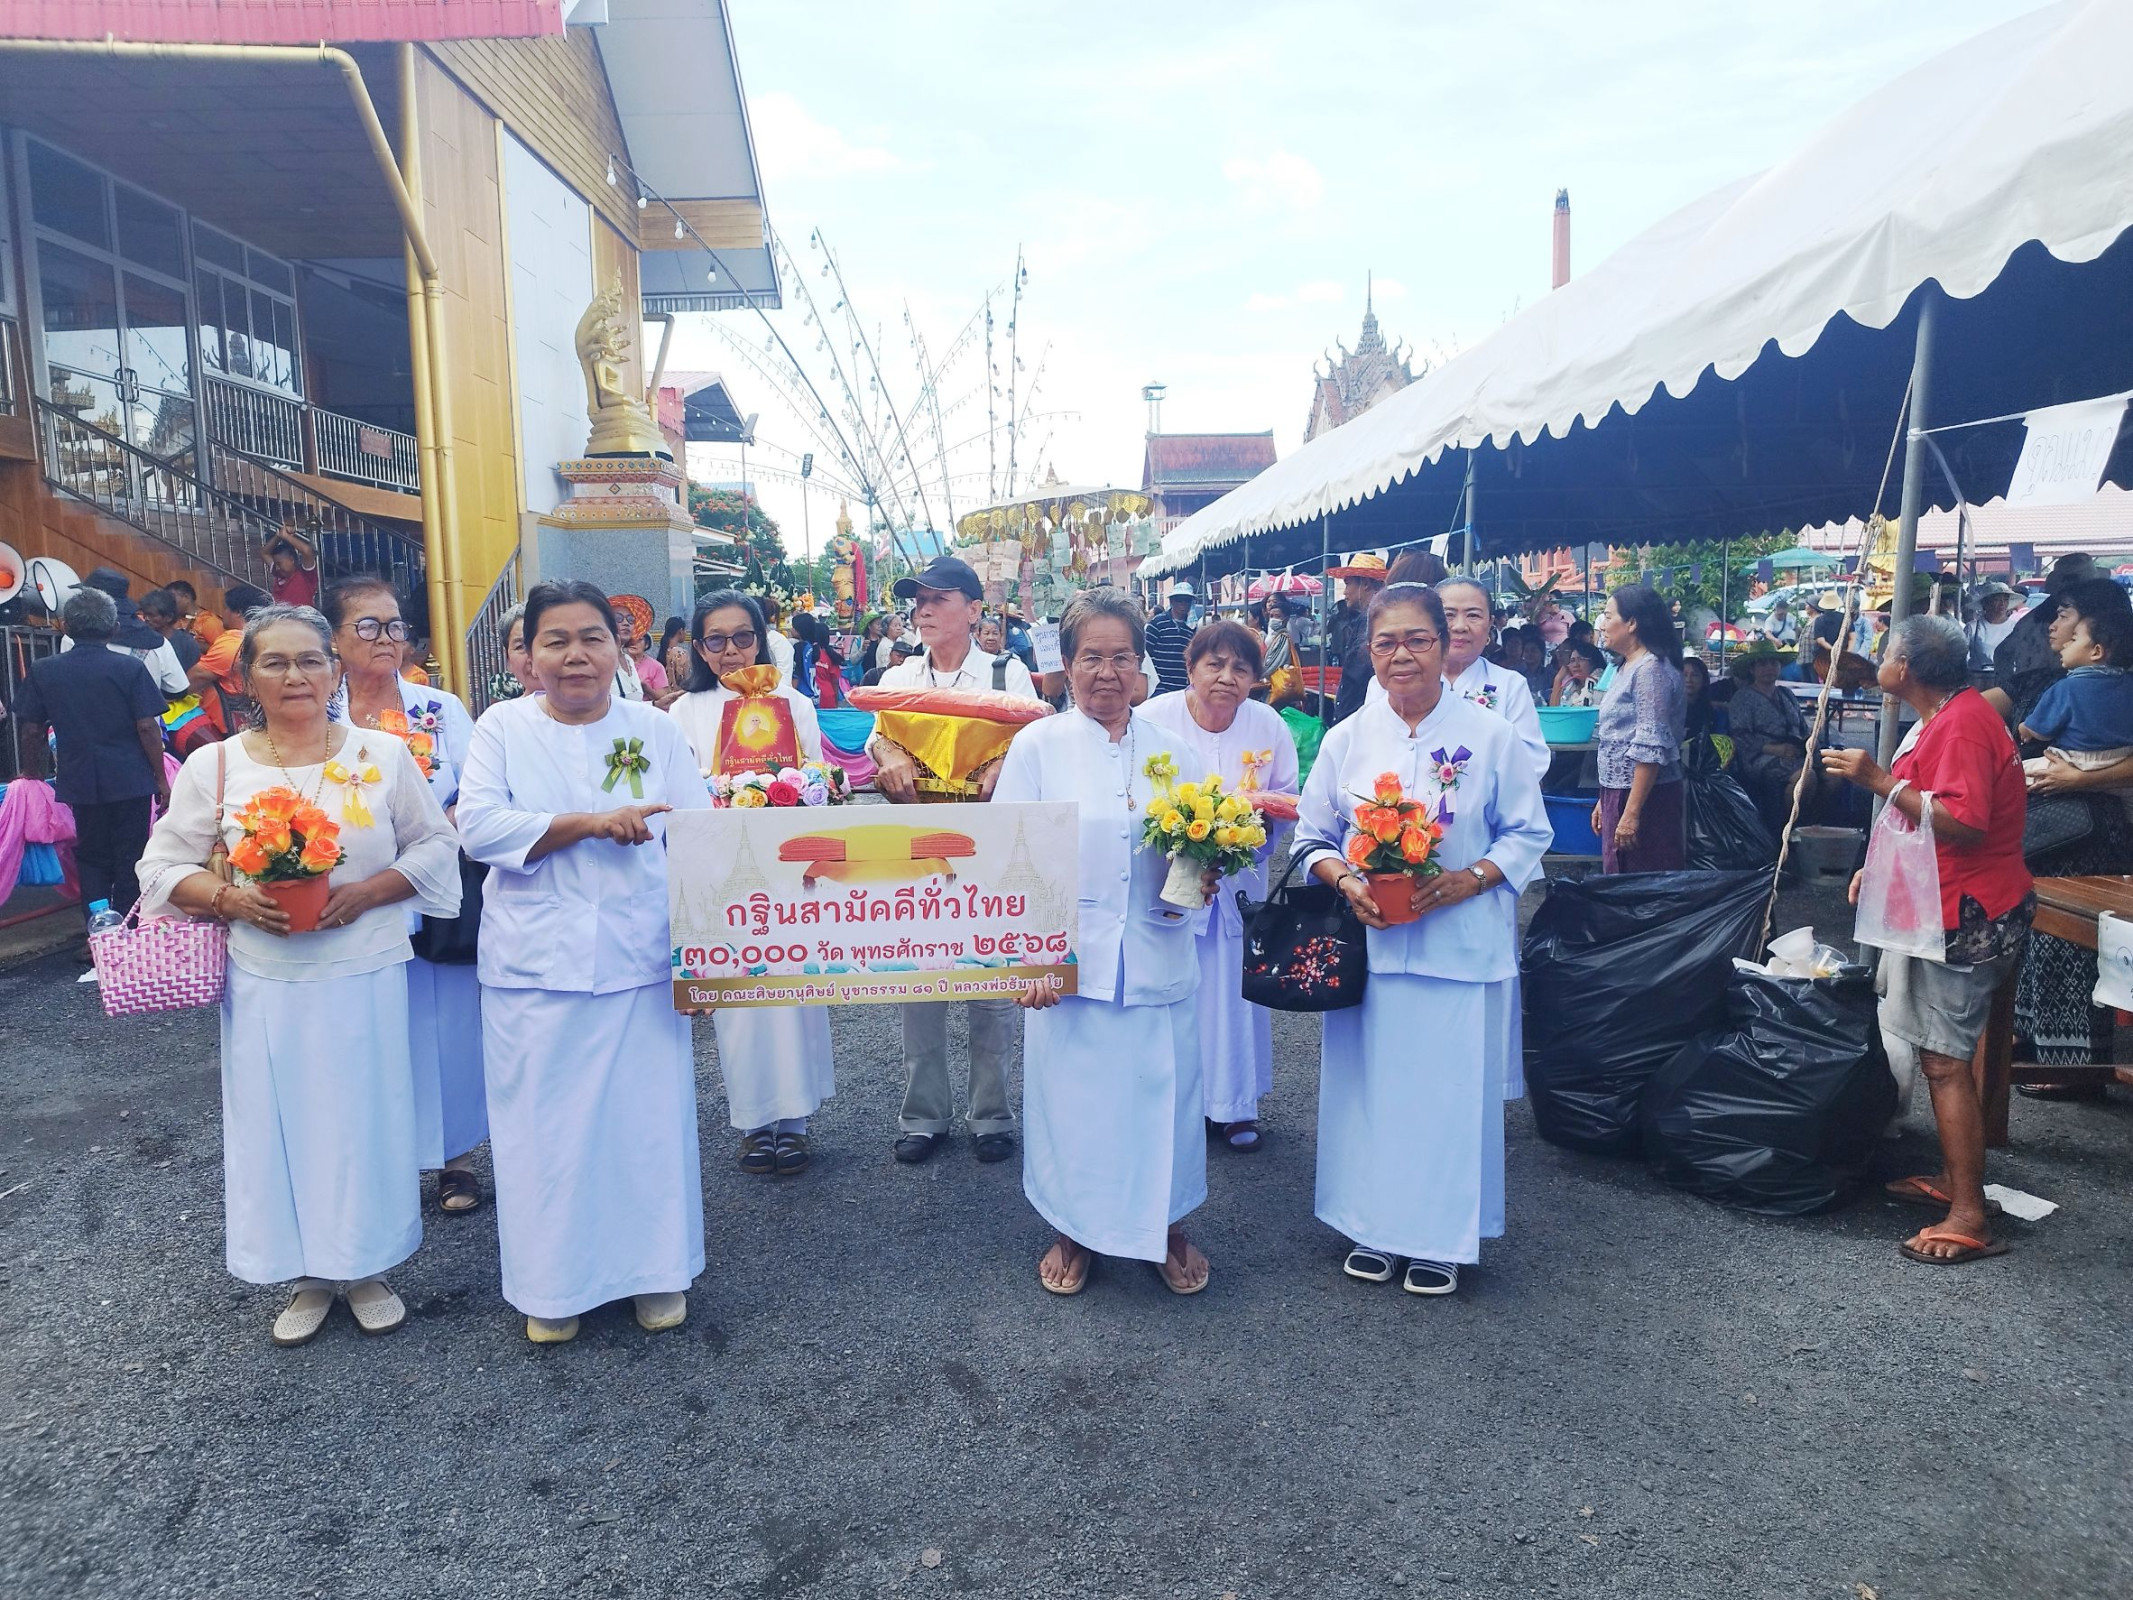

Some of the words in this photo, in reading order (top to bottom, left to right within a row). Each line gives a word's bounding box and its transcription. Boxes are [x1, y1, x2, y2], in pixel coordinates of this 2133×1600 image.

[726, 878, 1026, 936] กฐินสามัคคีทั่วไทย
[684, 944, 809, 969] ๓๐,๐๐๐
[817, 940, 844, 961] วัด
[851, 938, 964, 967] พุทธศักราช
[973, 931, 1067, 956] ๒๕๖๘
[690, 987, 717, 1002] โดย
[723, 983, 835, 1004] คณะศิษยานุศิษย์
[841, 984, 907, 1001] บูชาธรรม
[912, 985, 933, 996] ๘๑
[938, 978, 948, 993] ปี
